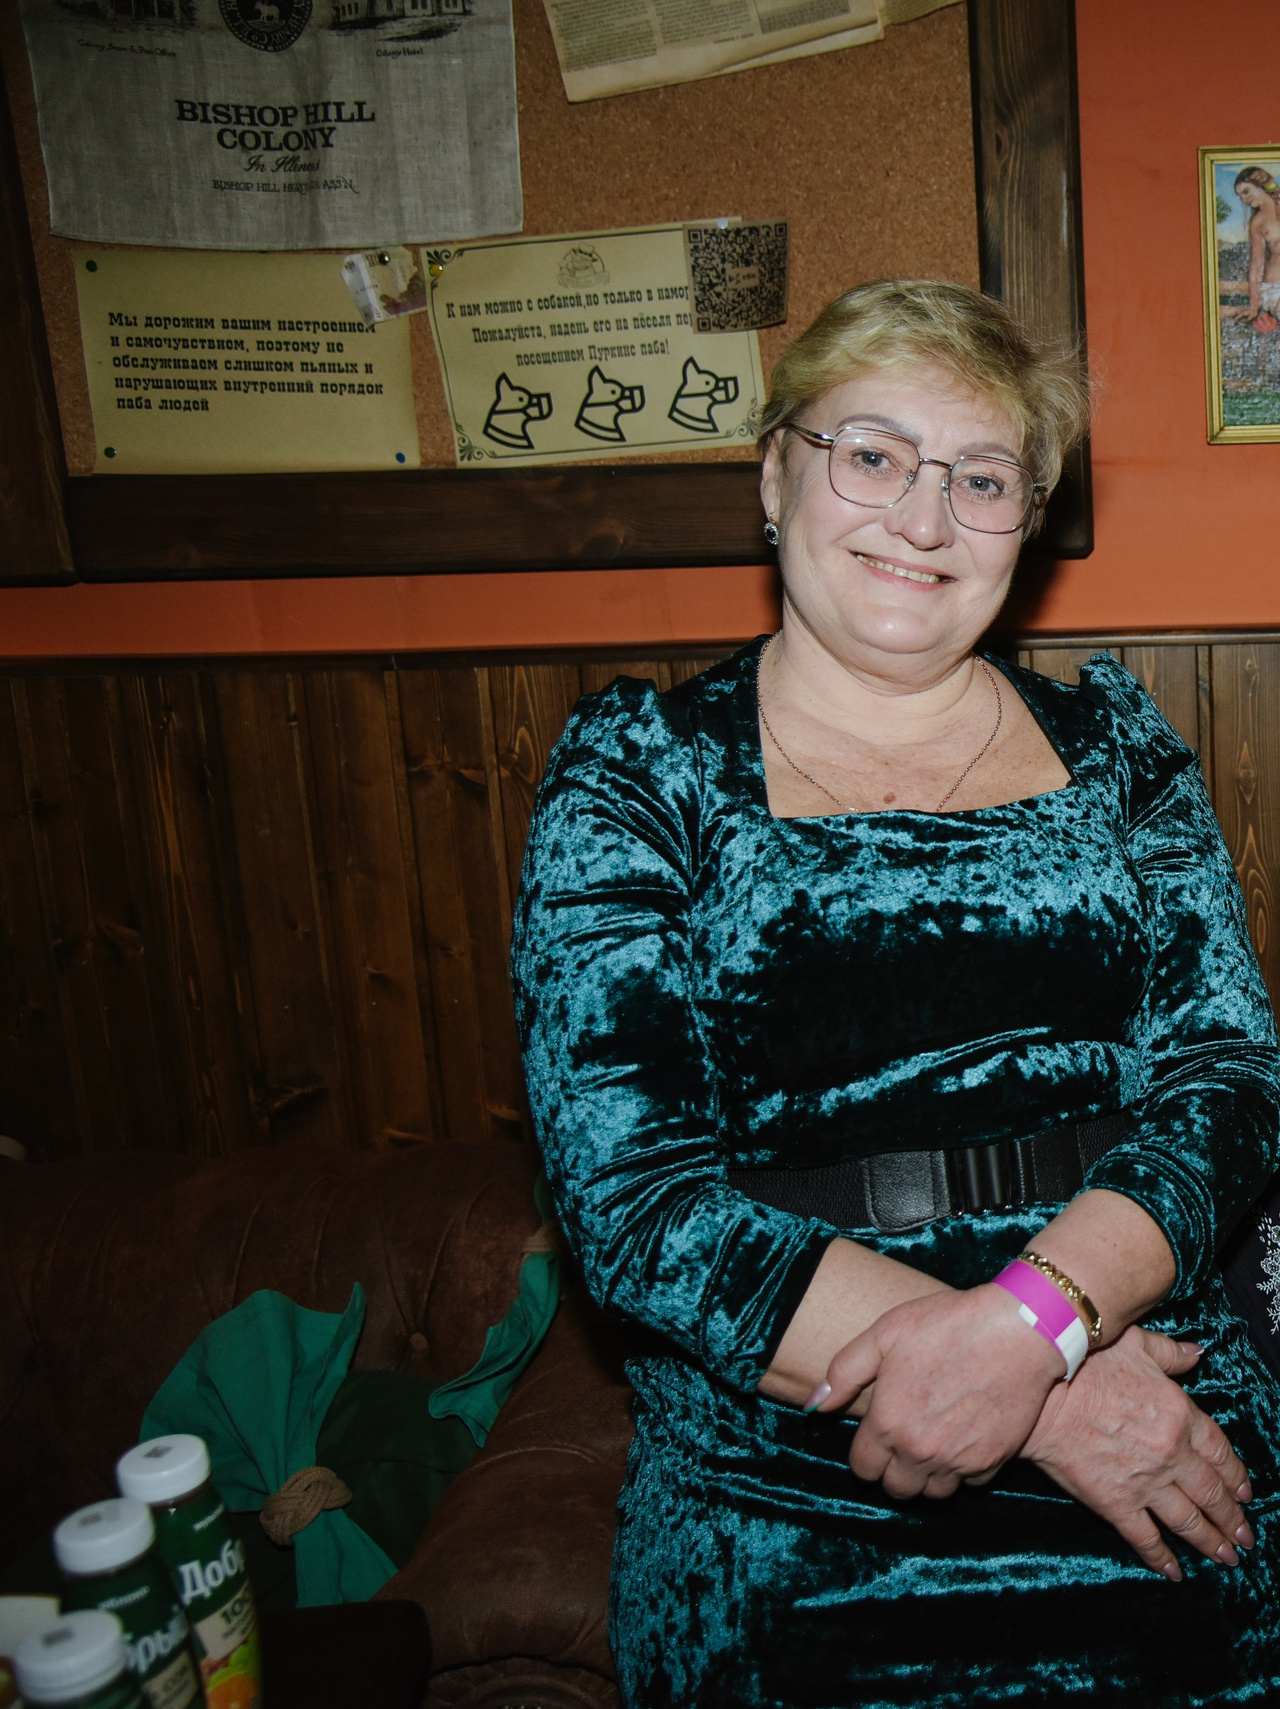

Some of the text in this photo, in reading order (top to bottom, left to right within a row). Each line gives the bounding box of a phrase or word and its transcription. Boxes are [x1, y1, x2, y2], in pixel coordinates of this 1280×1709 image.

[175, 99, 375, 127] BISHOP HILL
[216, 126, 337, 151] COLONY
[244, 154, 266, 173] In
[212, 178, 254, 192] BISHOP
[257, 182, 280, 193] HILL
[446, 302, 456, 318] К
[459, 302, 482, 318] нам
[485, 299, 523, 315] можно
[527, 299, 533, 312] с
[603, 289, 643, 306] только
[646, 289, 653, 301] в
[108, 312, 376, 334] Мы дорожим вашим настроением
[472, 323, 547, 343] Пожалуйста,
[549, 320, 589, 337] надень
[593, 319, 612, 333] его
[615, 317, 629, 332] на
[110, 336, 344, 354] и самочувствием, поэтому не
[516, 349, 584, 367] посещением
[640, 339, 670, 355] паба!
[112, 355, 373, 375] обслуживаем слишком пьяных и
[114, 376, 384, 396] нарушающих внутренний порядок
[116, 396, 210, 412] паба людей
